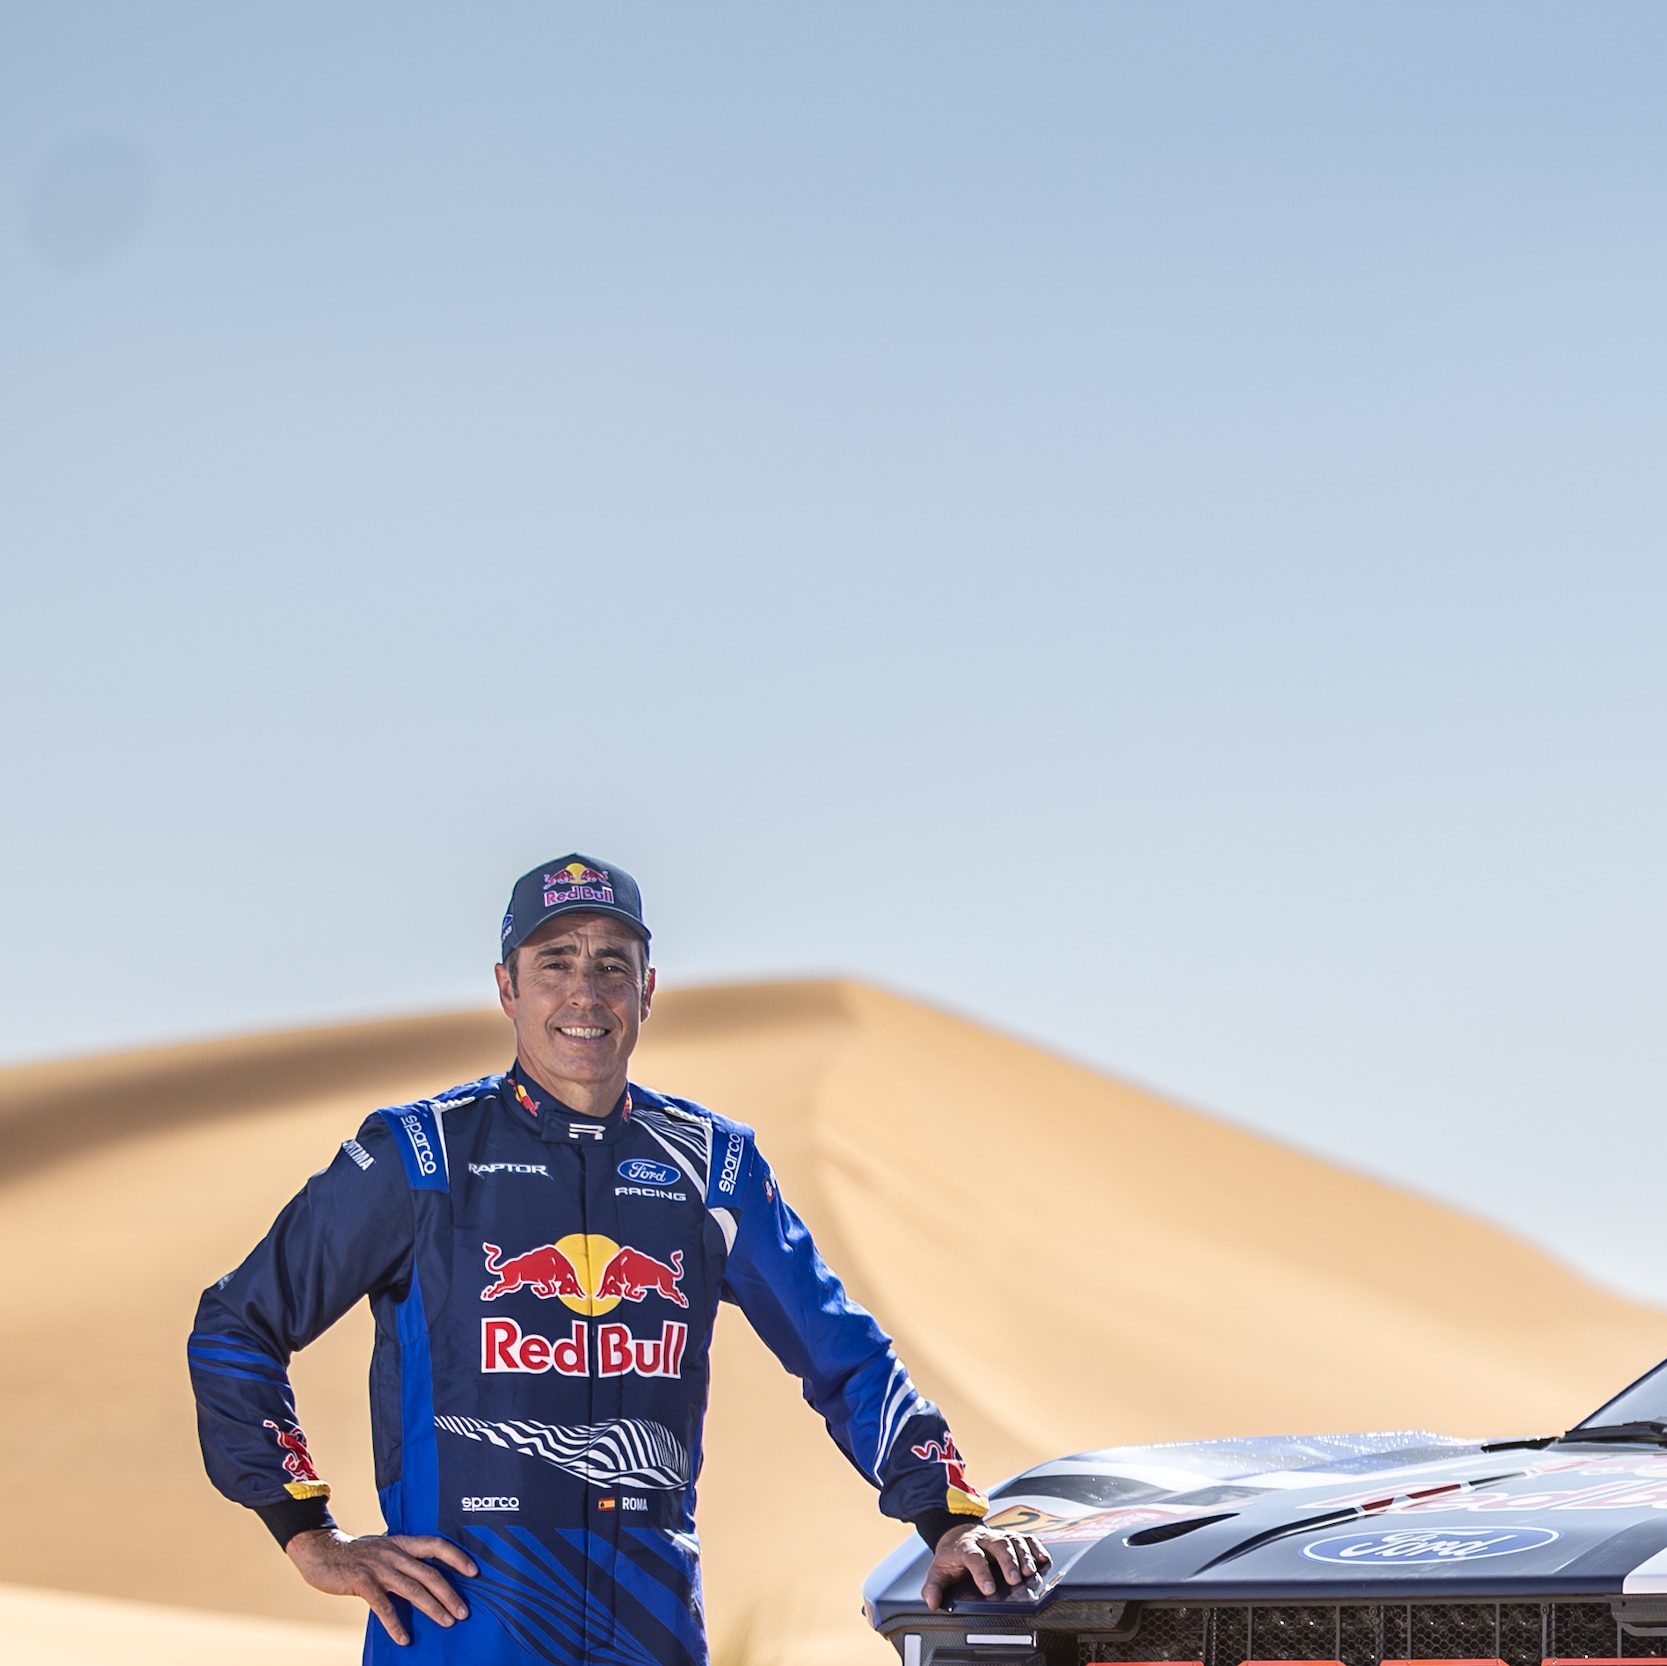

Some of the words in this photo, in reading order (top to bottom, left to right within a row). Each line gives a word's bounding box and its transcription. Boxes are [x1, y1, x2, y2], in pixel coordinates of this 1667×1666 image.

[544, 886, 580, 907] Red
[581, 886, 615, 904] Bull
[401, 1114, 437, 1177] sparco
[468, 1162, 553, 1180] RAPTOR
[628, 1162, 667, 1183] Ford
[719, 1132, 744, 1195] sparco
[614, 1187, 686, 1201] RACING
[481, 1317, 590, 1377] Red
[598, 1320, 688, 1379] Bull
[461, 1496, 519, 1512] sparco
[622, 1497, 648, 1511] ROMA
[1339, 1530, 1517, 1558] Ford
